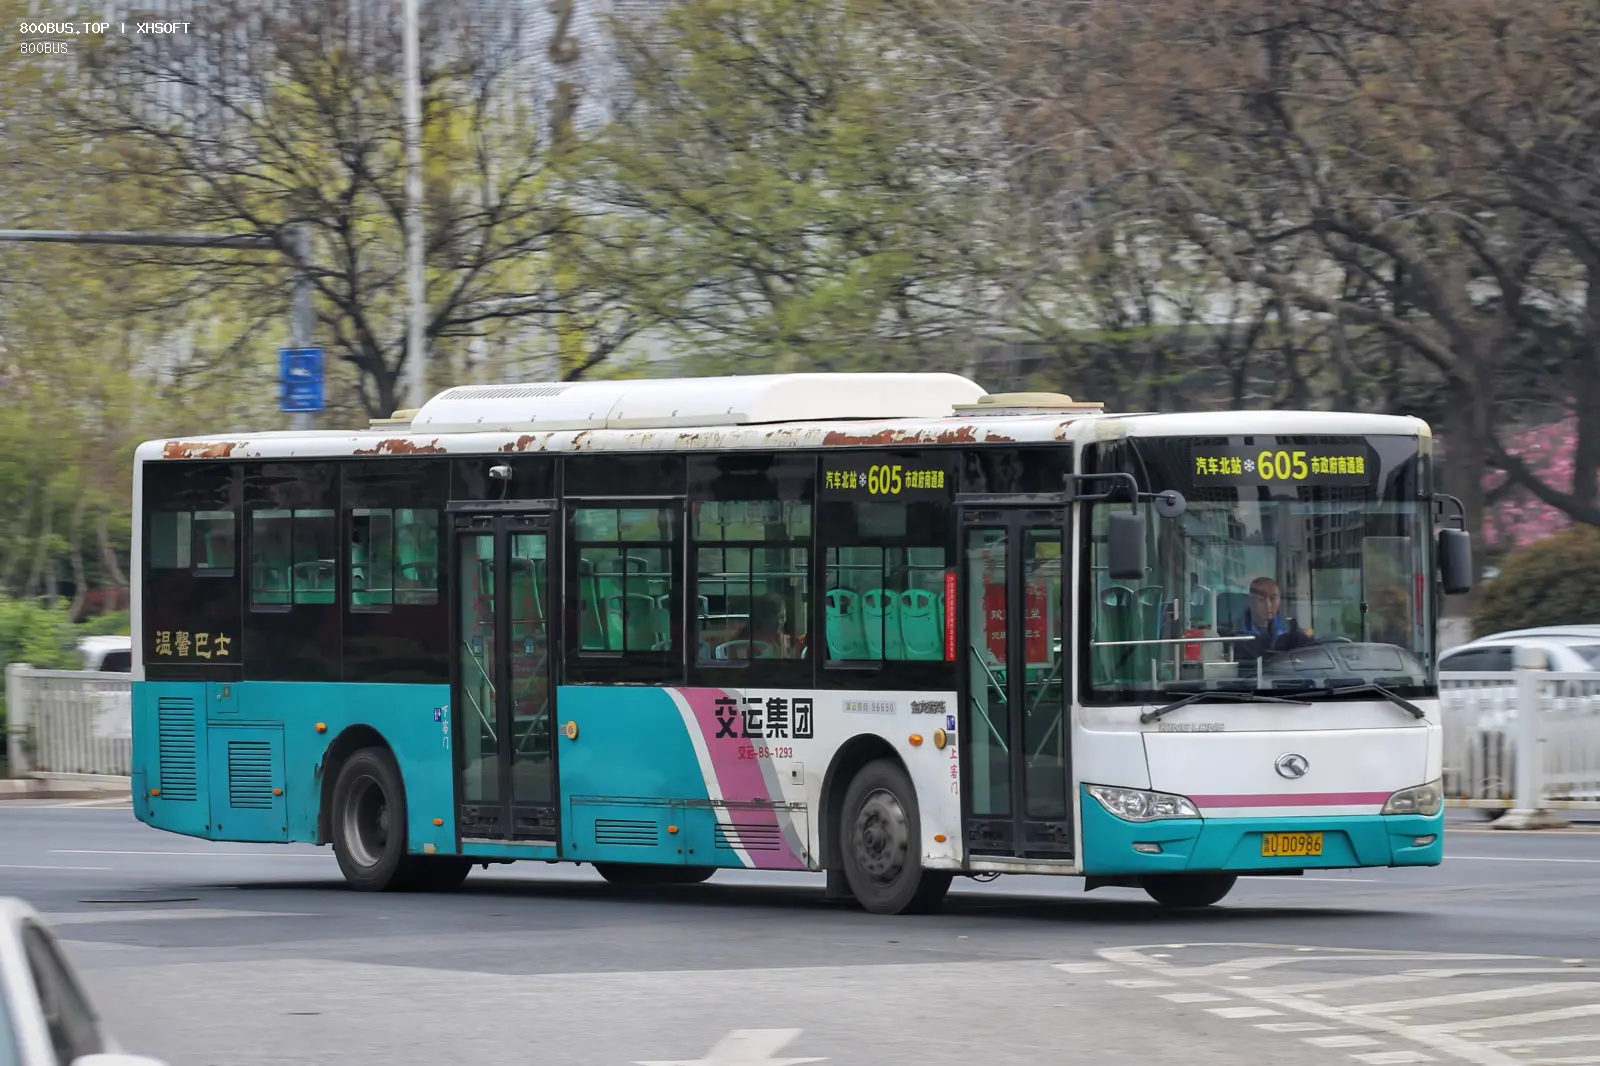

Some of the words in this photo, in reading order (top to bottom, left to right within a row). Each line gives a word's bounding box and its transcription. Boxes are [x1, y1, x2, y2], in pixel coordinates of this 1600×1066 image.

[825, 471, 857, 490] 汽车北站
[868, 465, 902, 495] 605
[1195, 456, 1242, 475] 汽车北站
[1257, 450, 1308, 480] 605
[714, 697, 814, 740] 交运集团
